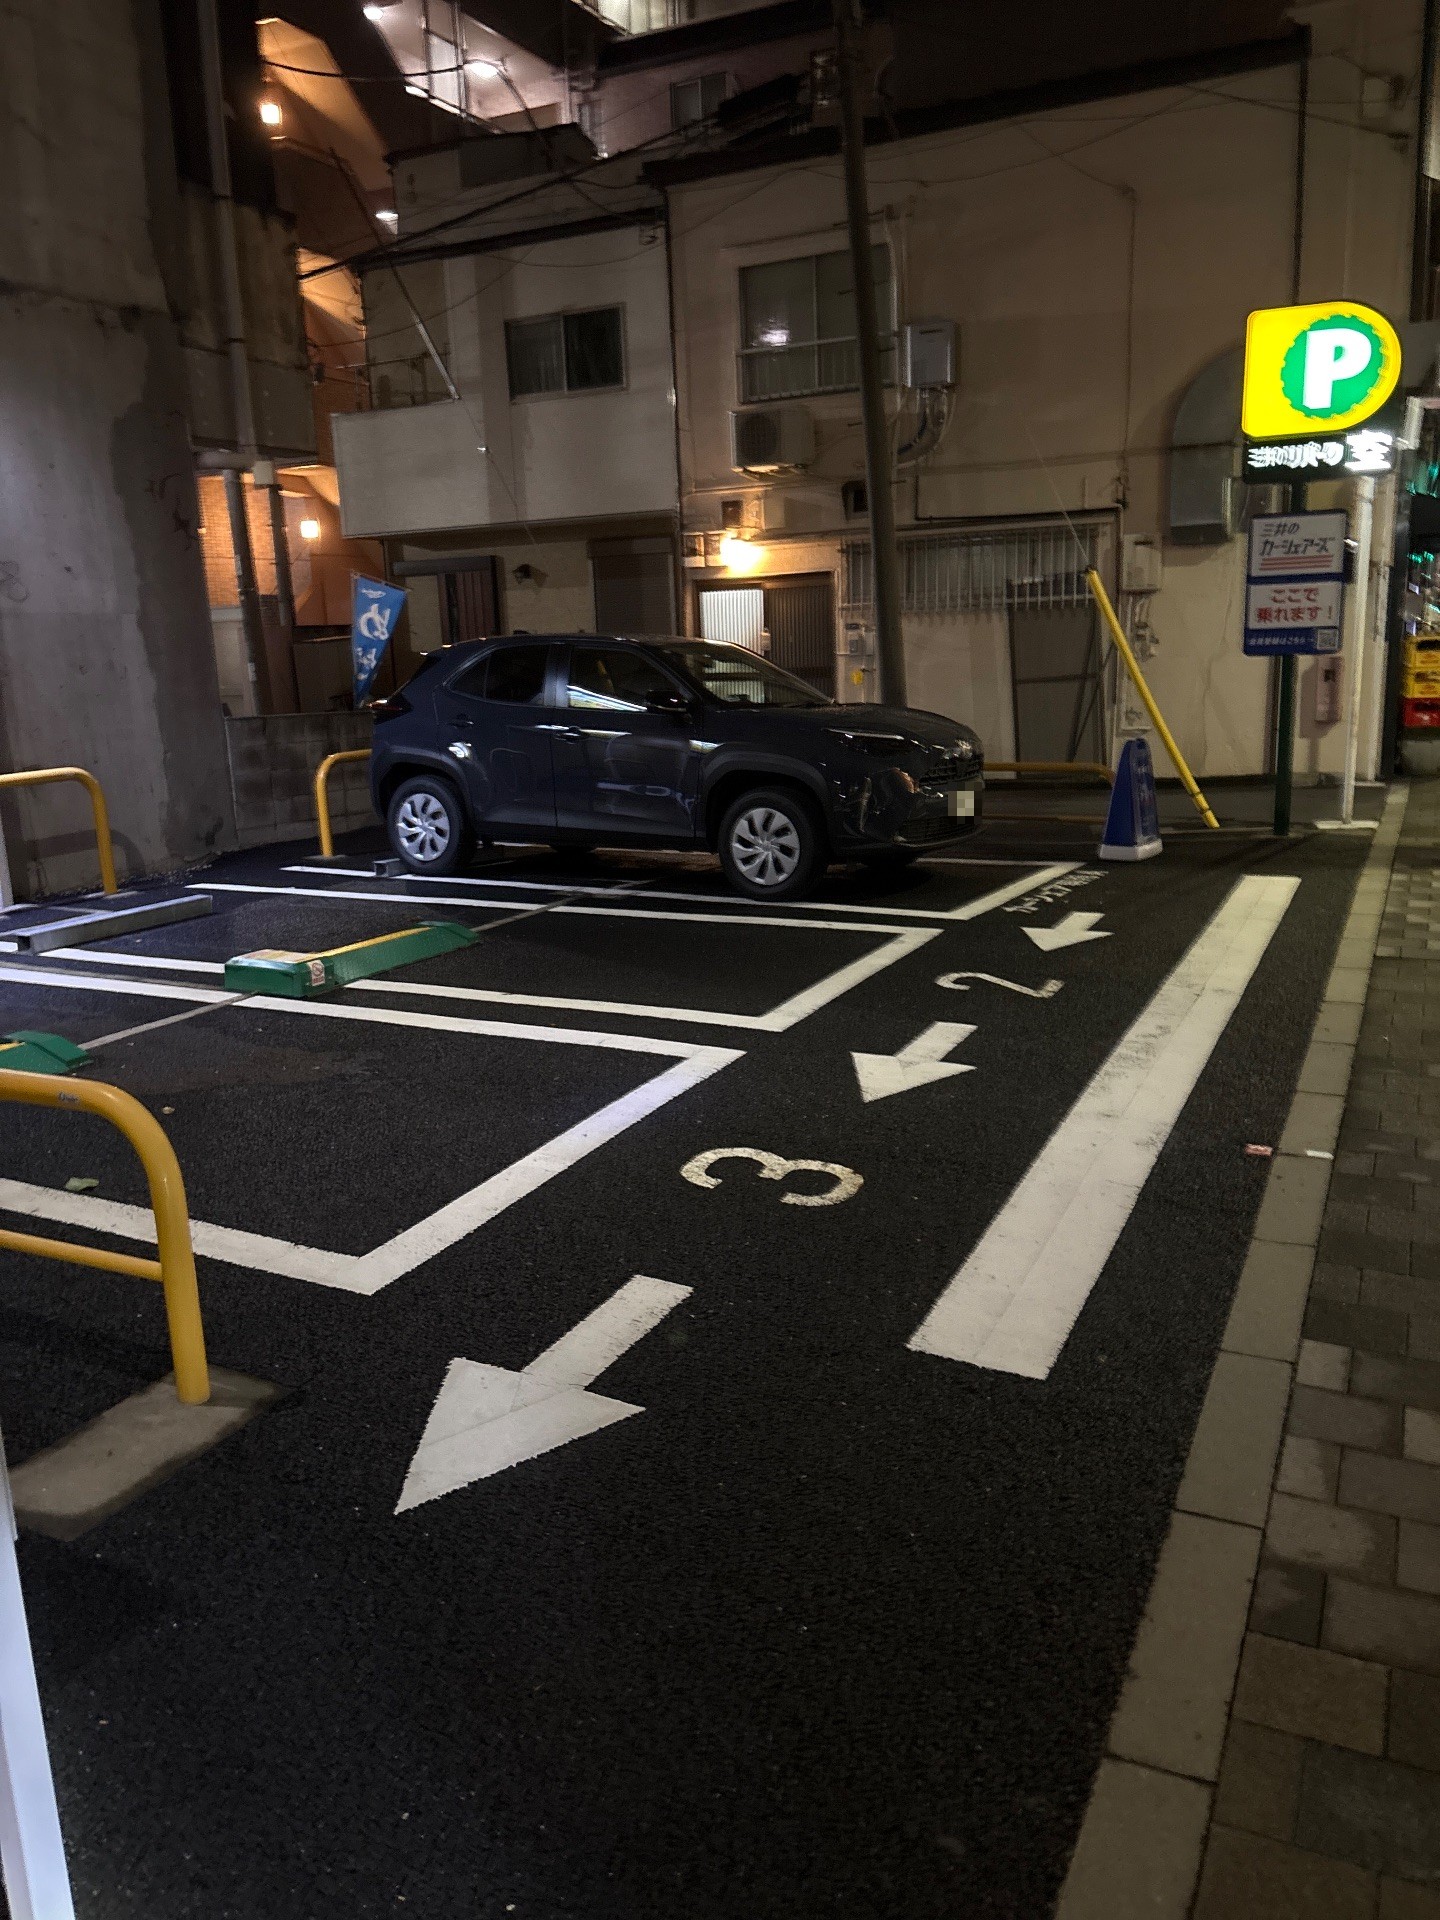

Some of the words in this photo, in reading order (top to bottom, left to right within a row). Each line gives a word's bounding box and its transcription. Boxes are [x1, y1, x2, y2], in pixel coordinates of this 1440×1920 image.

[1303, 328, 1371, 409] P
[1260, 522, 1300, 537] 三井の
[1271, 588, 1319, 604] ここで
[935, 971, 1065, 999] 2
[679, 1146, 865, 1207] 3
